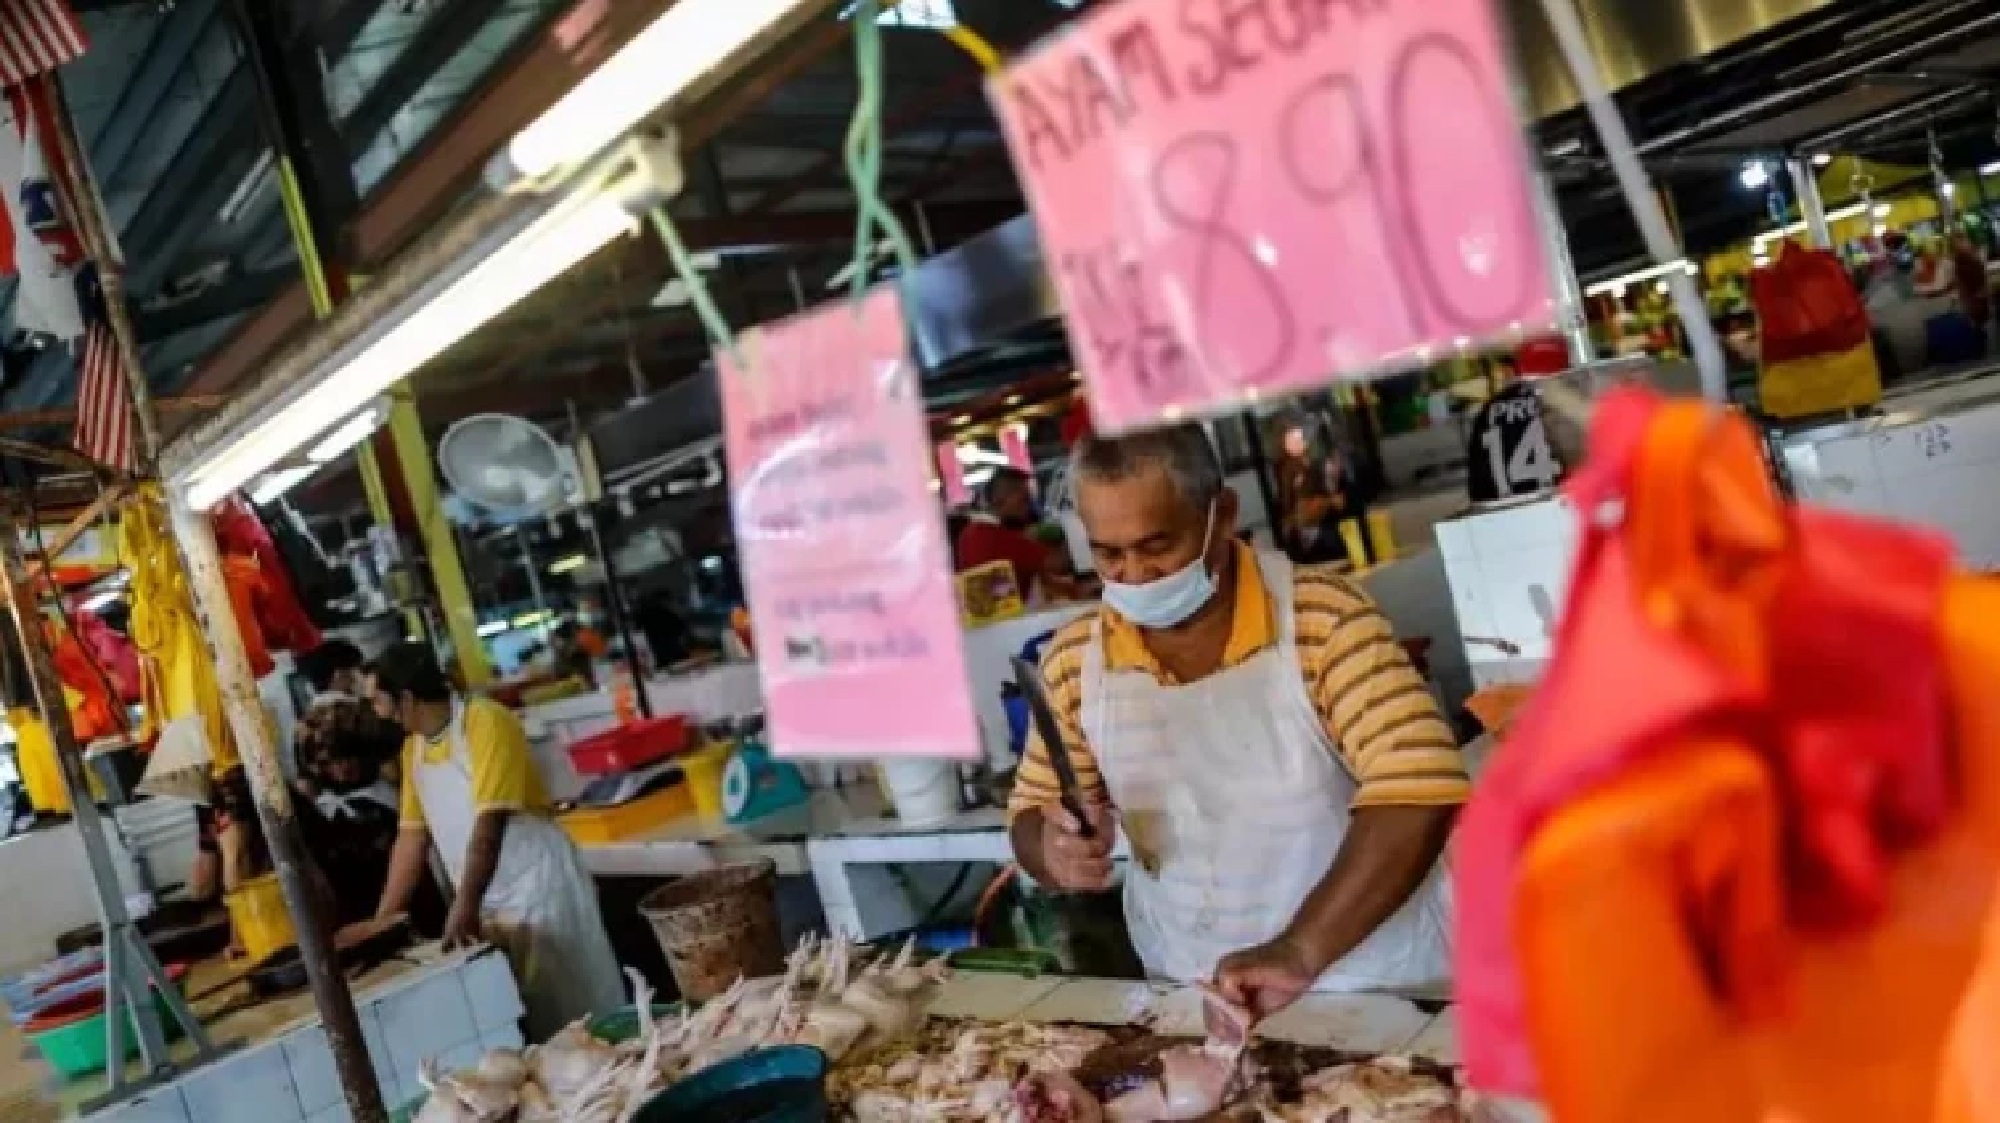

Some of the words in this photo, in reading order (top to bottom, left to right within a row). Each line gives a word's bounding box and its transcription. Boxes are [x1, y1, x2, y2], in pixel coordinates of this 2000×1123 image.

[1013, 20, 1178, 172] AYAM
[1177, 0, 1393, 95] SEG
[1481, 420, 1563, 497] 14
